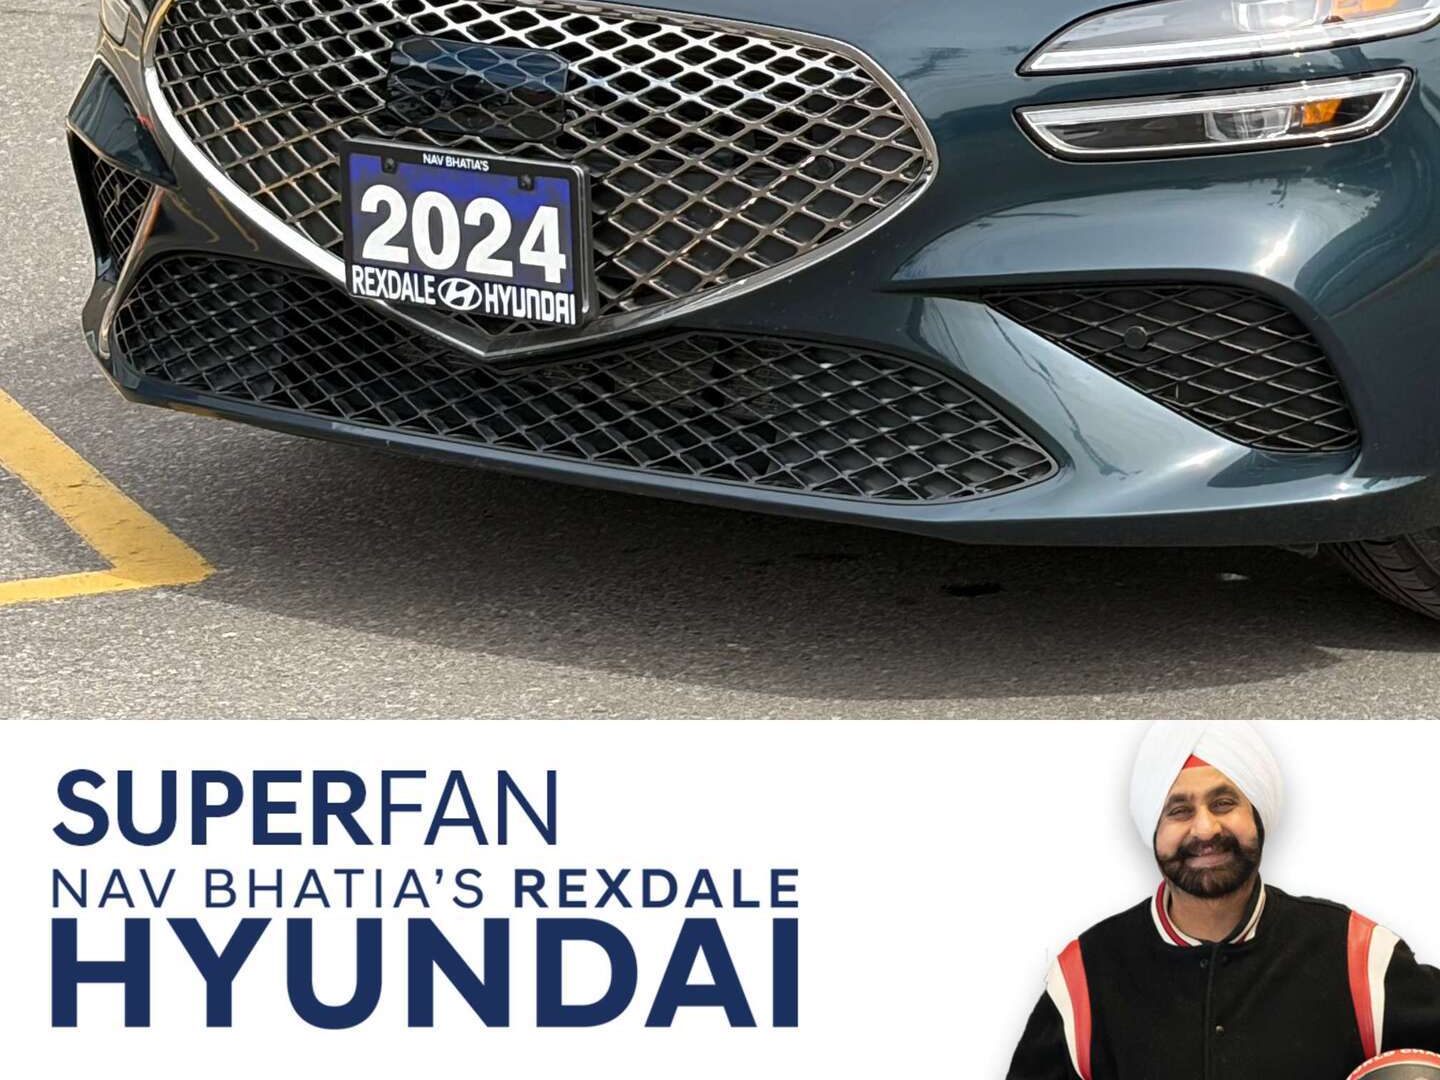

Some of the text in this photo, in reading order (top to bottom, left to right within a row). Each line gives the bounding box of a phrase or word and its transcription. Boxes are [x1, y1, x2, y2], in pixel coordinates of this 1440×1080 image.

[423, 153, 490, 172] NAV BHATIA'S
[361, 184, 567, 284] 2024
[352, 265, 577, 325] REXDALE HYUNDAI
